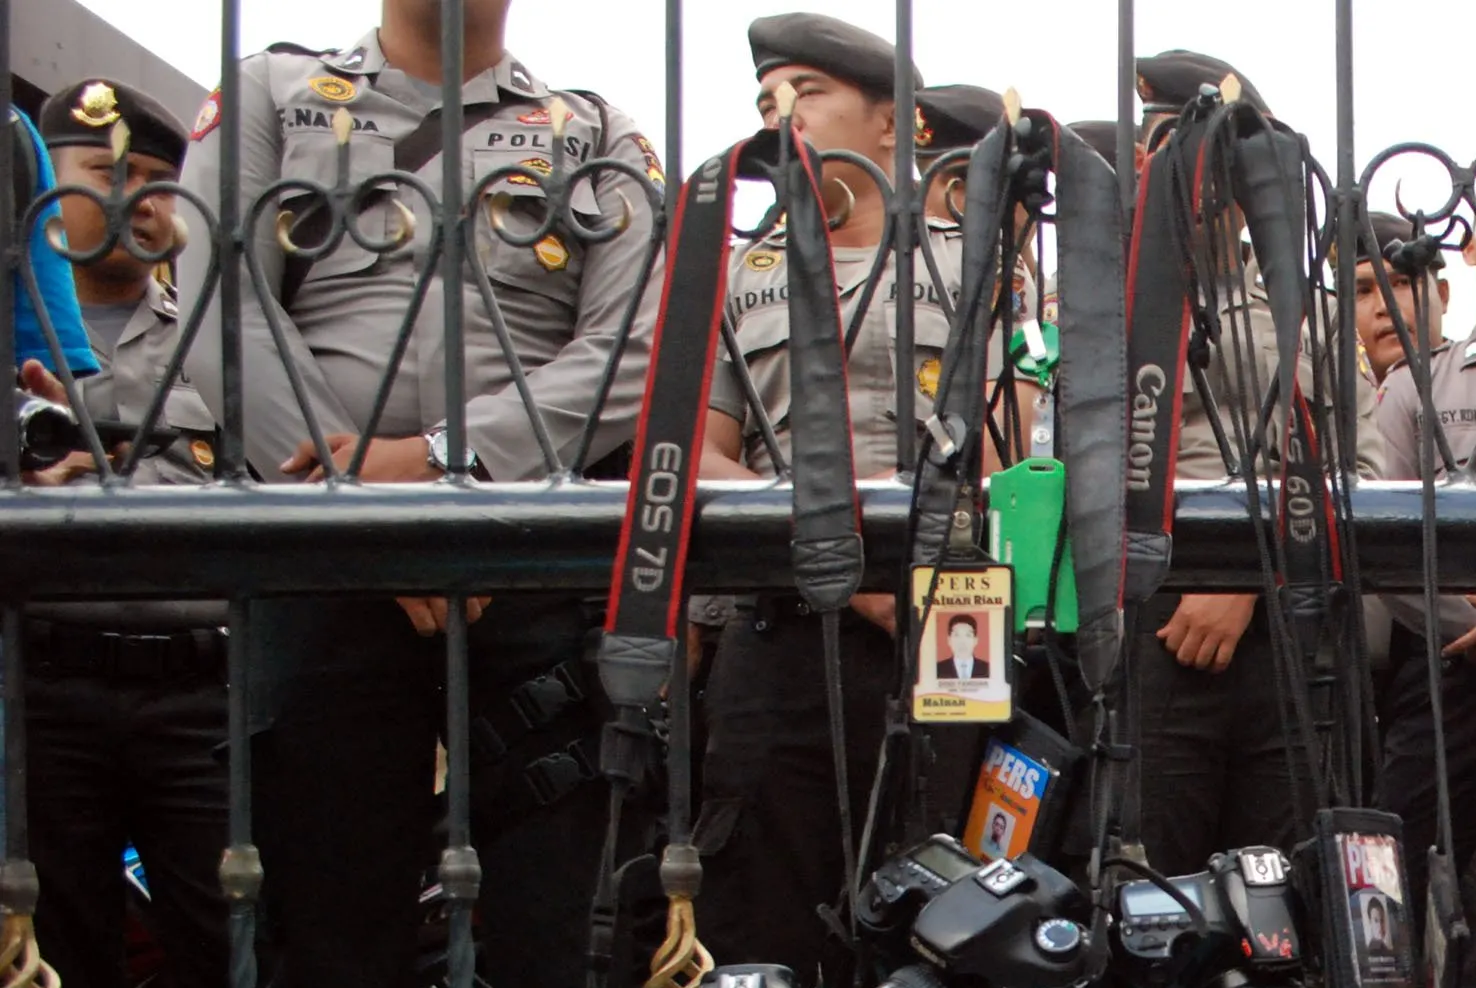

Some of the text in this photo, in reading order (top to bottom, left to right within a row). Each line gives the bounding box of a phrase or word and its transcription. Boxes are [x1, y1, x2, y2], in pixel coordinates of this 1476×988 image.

[279, 108, 380, 134] F.NADA
[488, 133, 591, 162] POLSI
[1127, 364, 1166, 491] Canon
[632, 442, 682, 592] EOS 7D
[1286, 475, 1316, 543] 60D
[936, 576, 991, 590] PERS
[985, 745, 1041, 801] PERS
